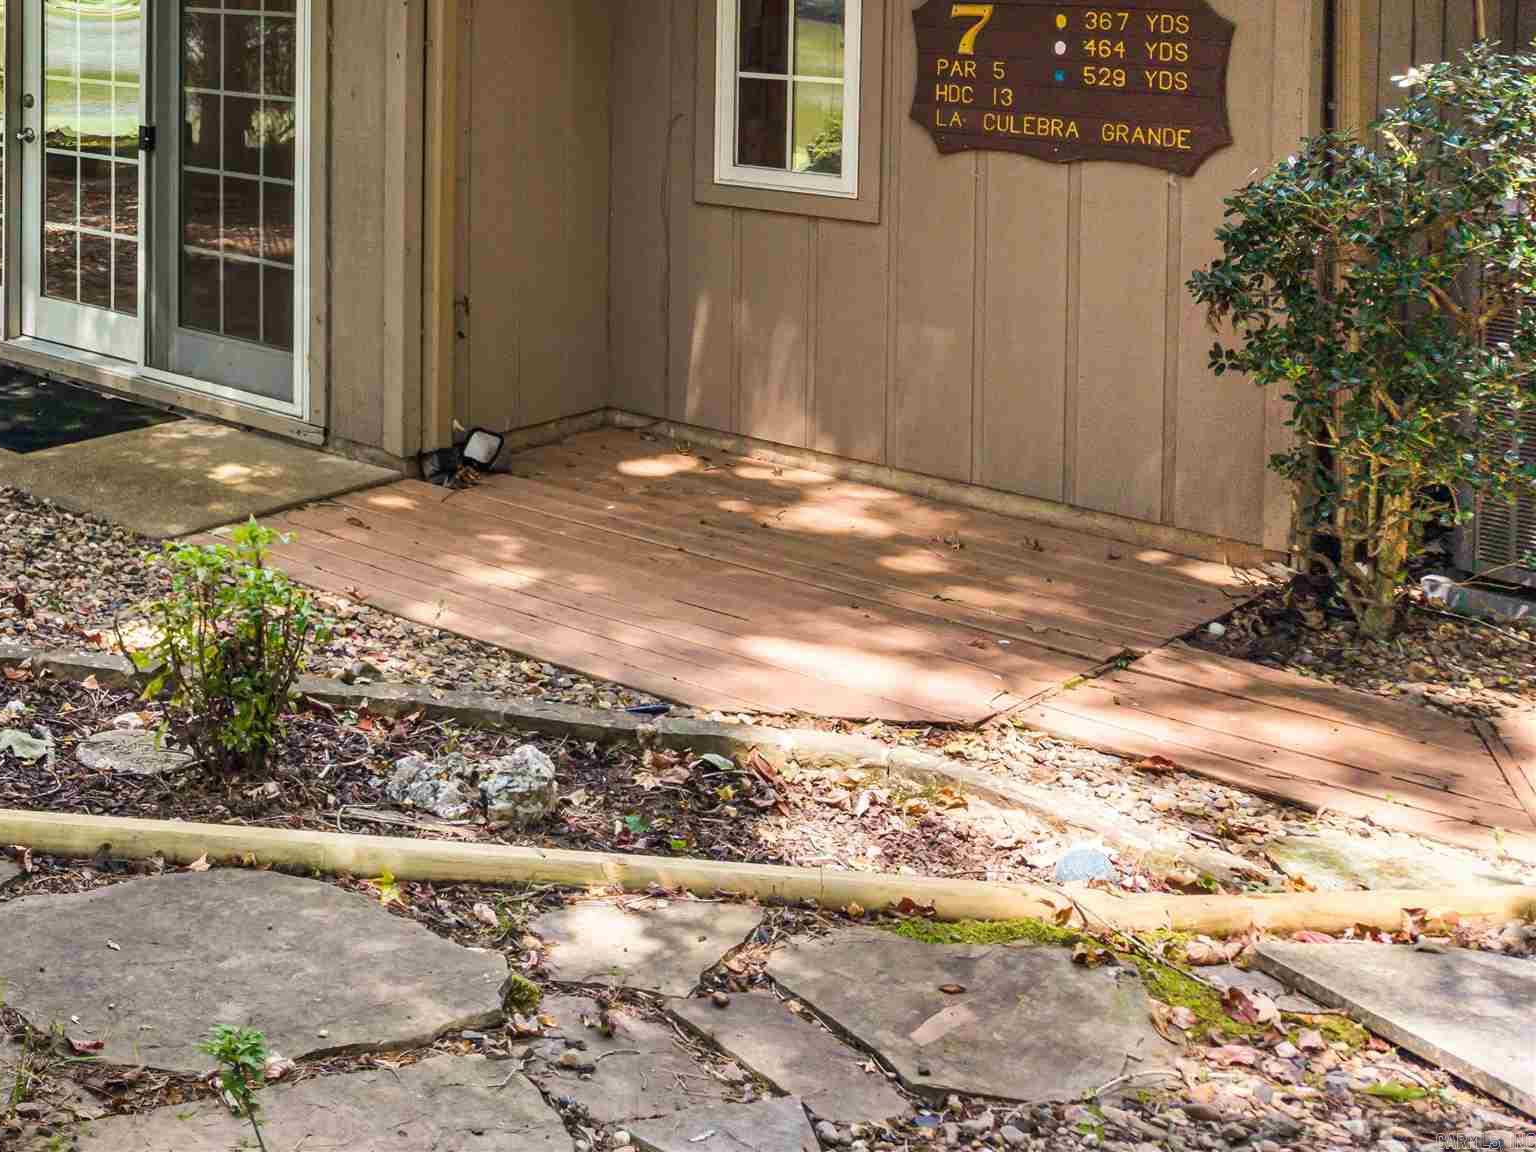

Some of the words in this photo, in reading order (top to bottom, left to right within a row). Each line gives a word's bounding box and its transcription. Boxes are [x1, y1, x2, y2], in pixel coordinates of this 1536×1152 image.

[951, 4, 993, 55] 7
[1084, 12, 1129, 30] 367
[1145, 14, 1190, 34] YDS
[1083, 40, 1126, 58] 464
[1145, 42, 1189, 62] YDS
[936, 59, 976, 79] PAR
[993, 62, 1005, 80] 5
[1083, 67, 1126, 87] 529
[1144, 70, 1189, 90] YDS
[935, 84, 974, 104] HDC
[993, 88, 1013, 106] 13
[936, 112, 961, 128] LA
[983, 114, 1079, 138] CULEBRA
[1102, 123, 1192, 149] GRANDE
